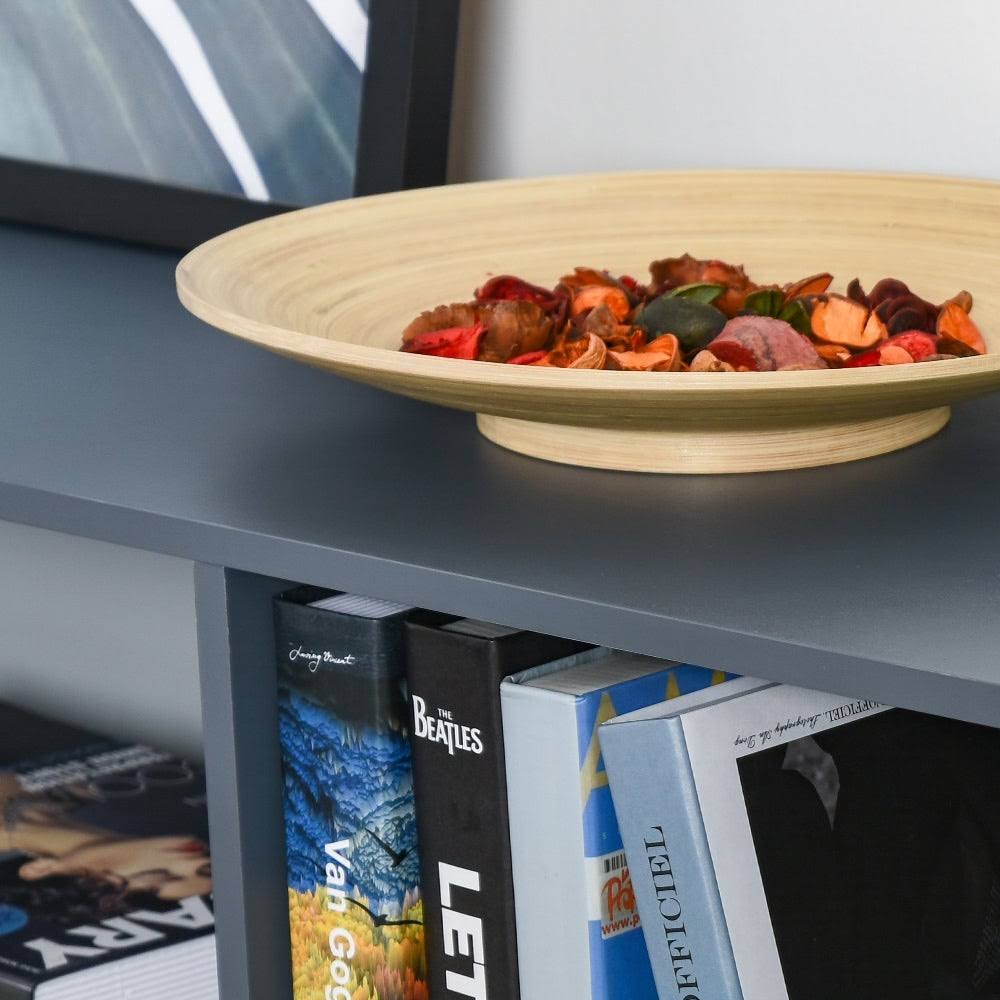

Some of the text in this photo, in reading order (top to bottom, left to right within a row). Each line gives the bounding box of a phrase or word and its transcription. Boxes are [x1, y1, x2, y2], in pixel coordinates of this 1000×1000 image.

[412, 694, 483, 755] BEATLES
[437, 707, 454, 721] THE
[324, 838, 351, 912] Van
